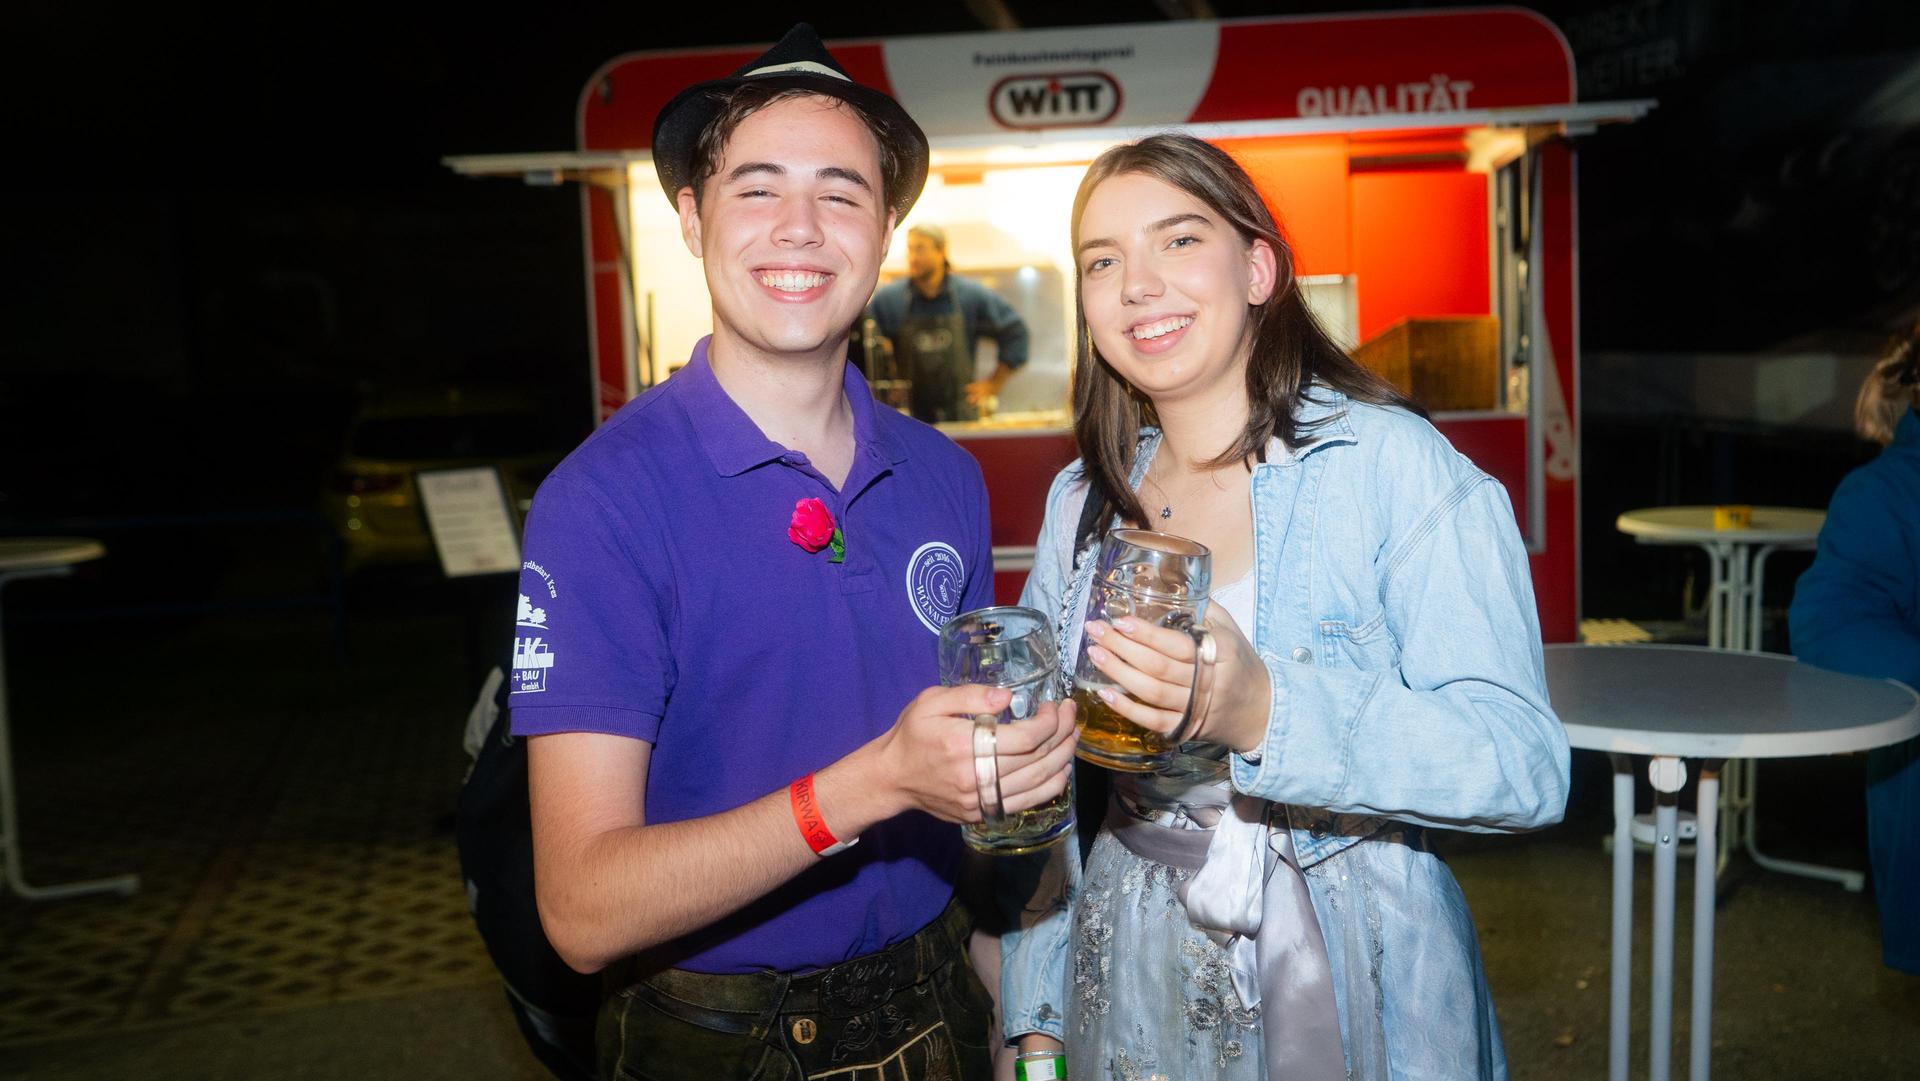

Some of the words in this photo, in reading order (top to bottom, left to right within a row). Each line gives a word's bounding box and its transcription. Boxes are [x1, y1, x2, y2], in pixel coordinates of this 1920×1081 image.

[1296, 73, 1474, 117] QUALITÄT
[522, 670, 540, 681] BAU
[521, 681, 540, 691] GmbH
